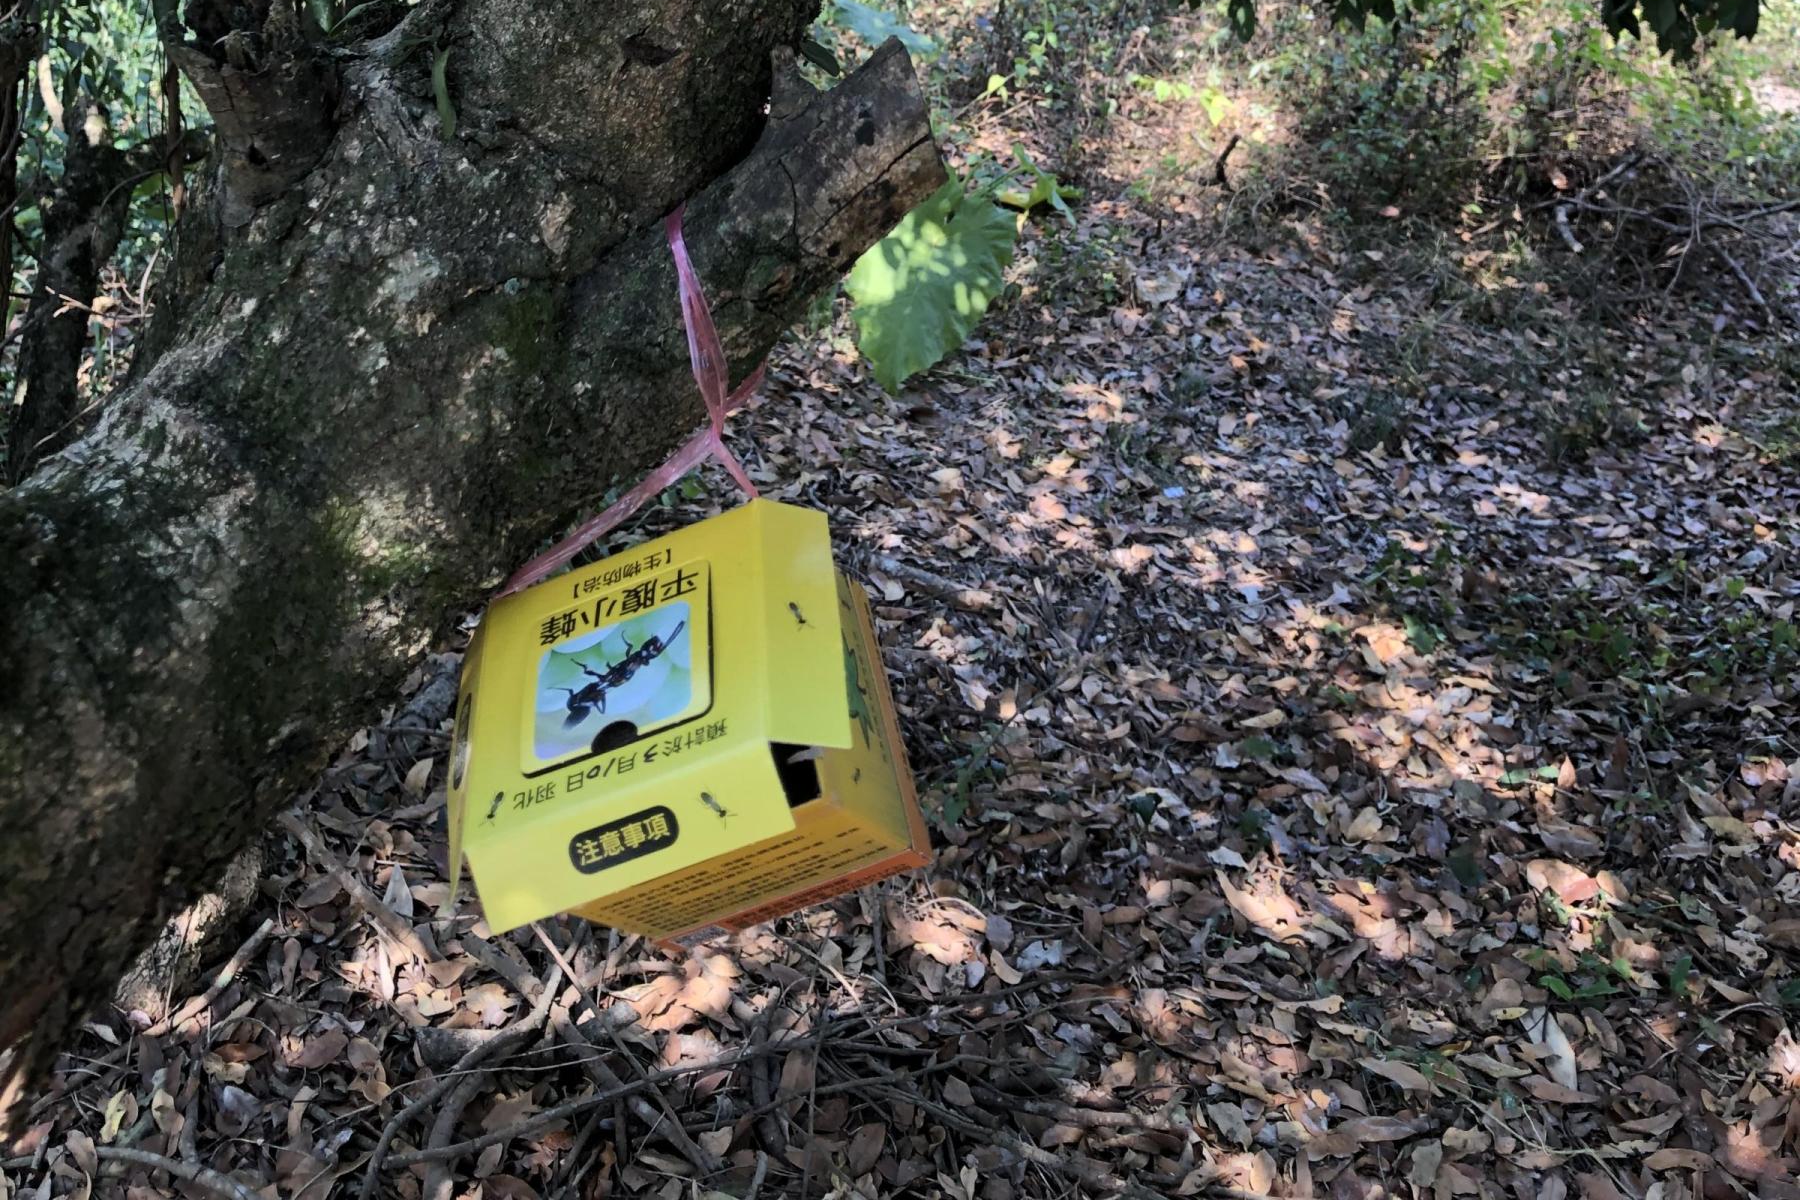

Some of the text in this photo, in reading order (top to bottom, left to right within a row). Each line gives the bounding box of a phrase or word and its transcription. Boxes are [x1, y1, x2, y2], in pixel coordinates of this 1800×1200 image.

[540, 569, 699, 646] 平腹小蜂
[576, 813, 671, 866] 注意事項
